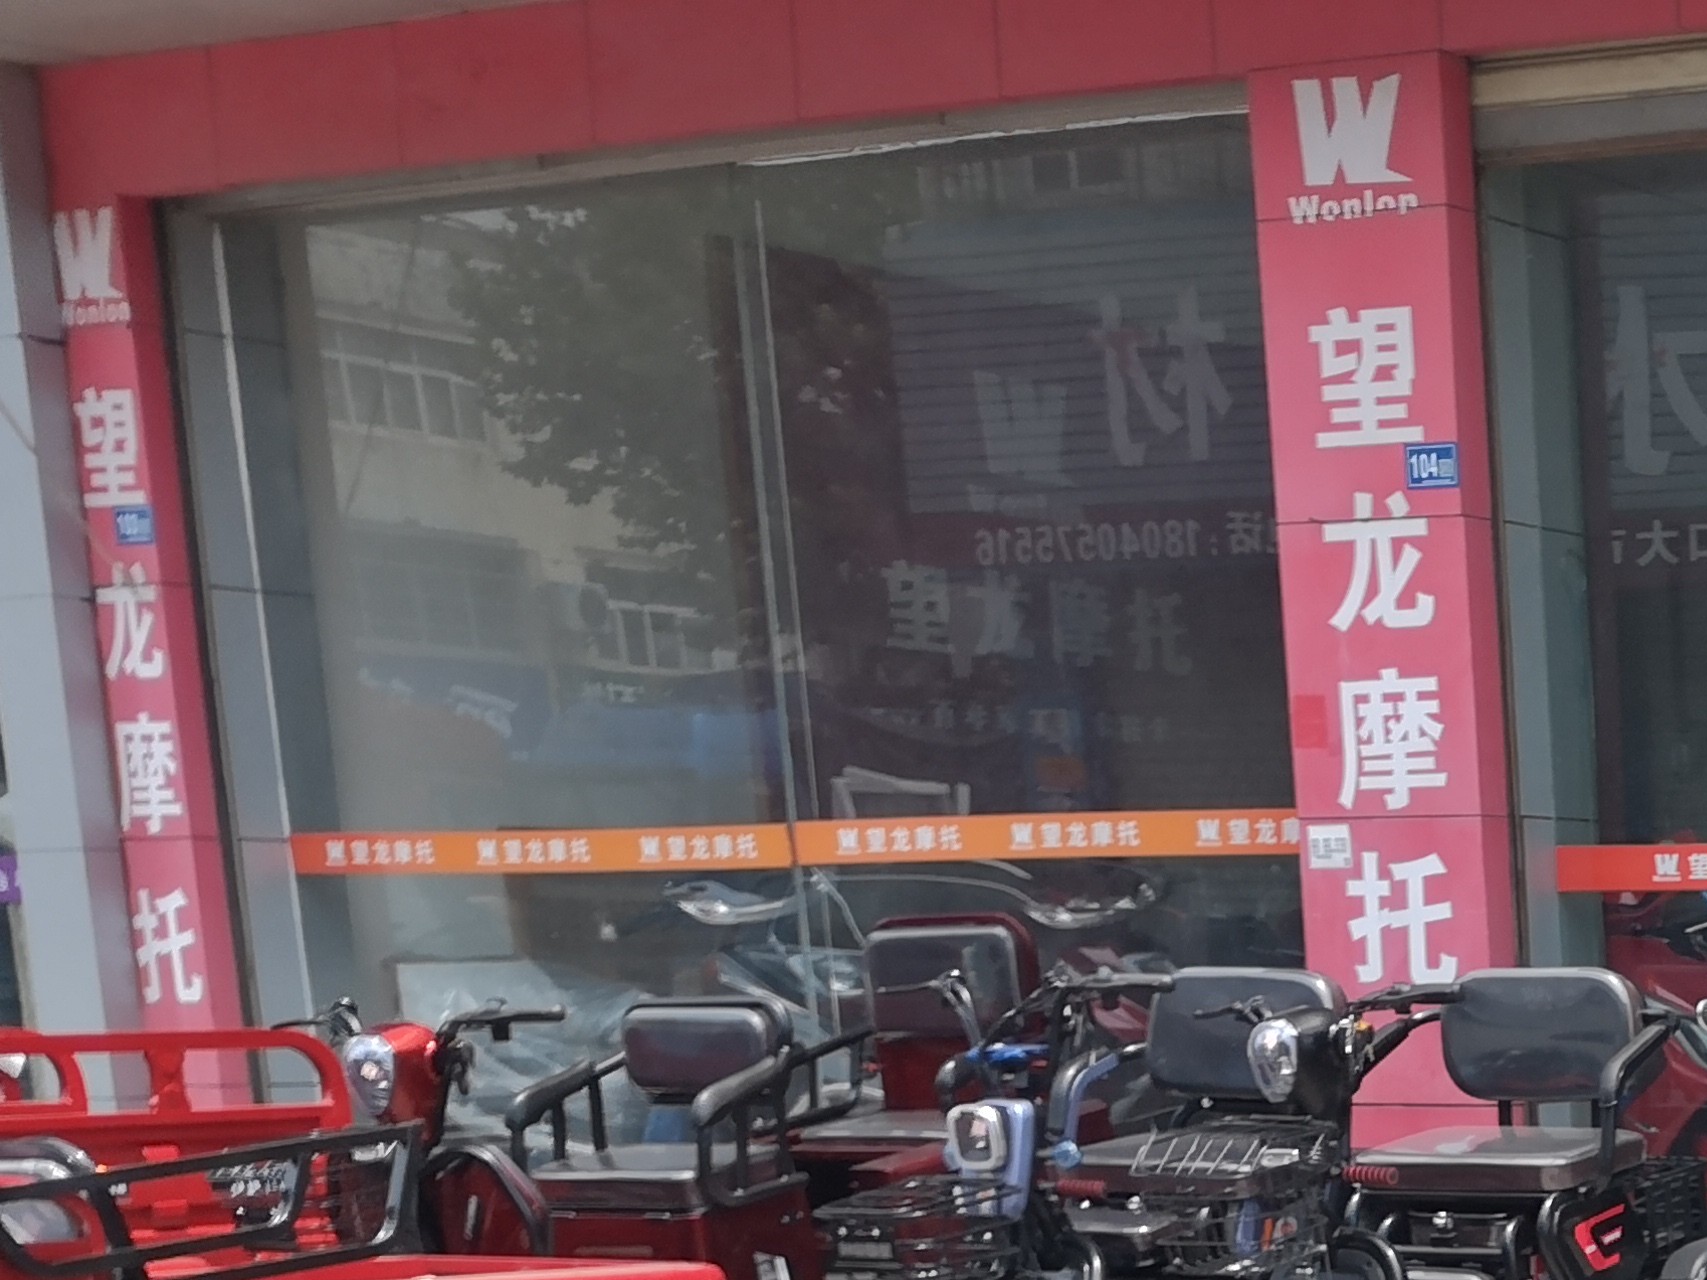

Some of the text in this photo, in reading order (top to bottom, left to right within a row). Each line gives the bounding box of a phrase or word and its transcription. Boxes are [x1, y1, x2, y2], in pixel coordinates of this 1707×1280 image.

[1409, 450, 1440, 480] 104
[1307, 306, 1459, 987] 望龙摩托
[72, 387, 203, 1004] 望龙摩托
[667, 833, 758, 862] 望龙摩托
[864, 825, 963, 854] 望龙摩托
[1040, 820, 1141, 849] 望龙摩托
[350, 838, 436, 866] 望龙摩托
[503, 837, 592, 865] 望龙摩托
